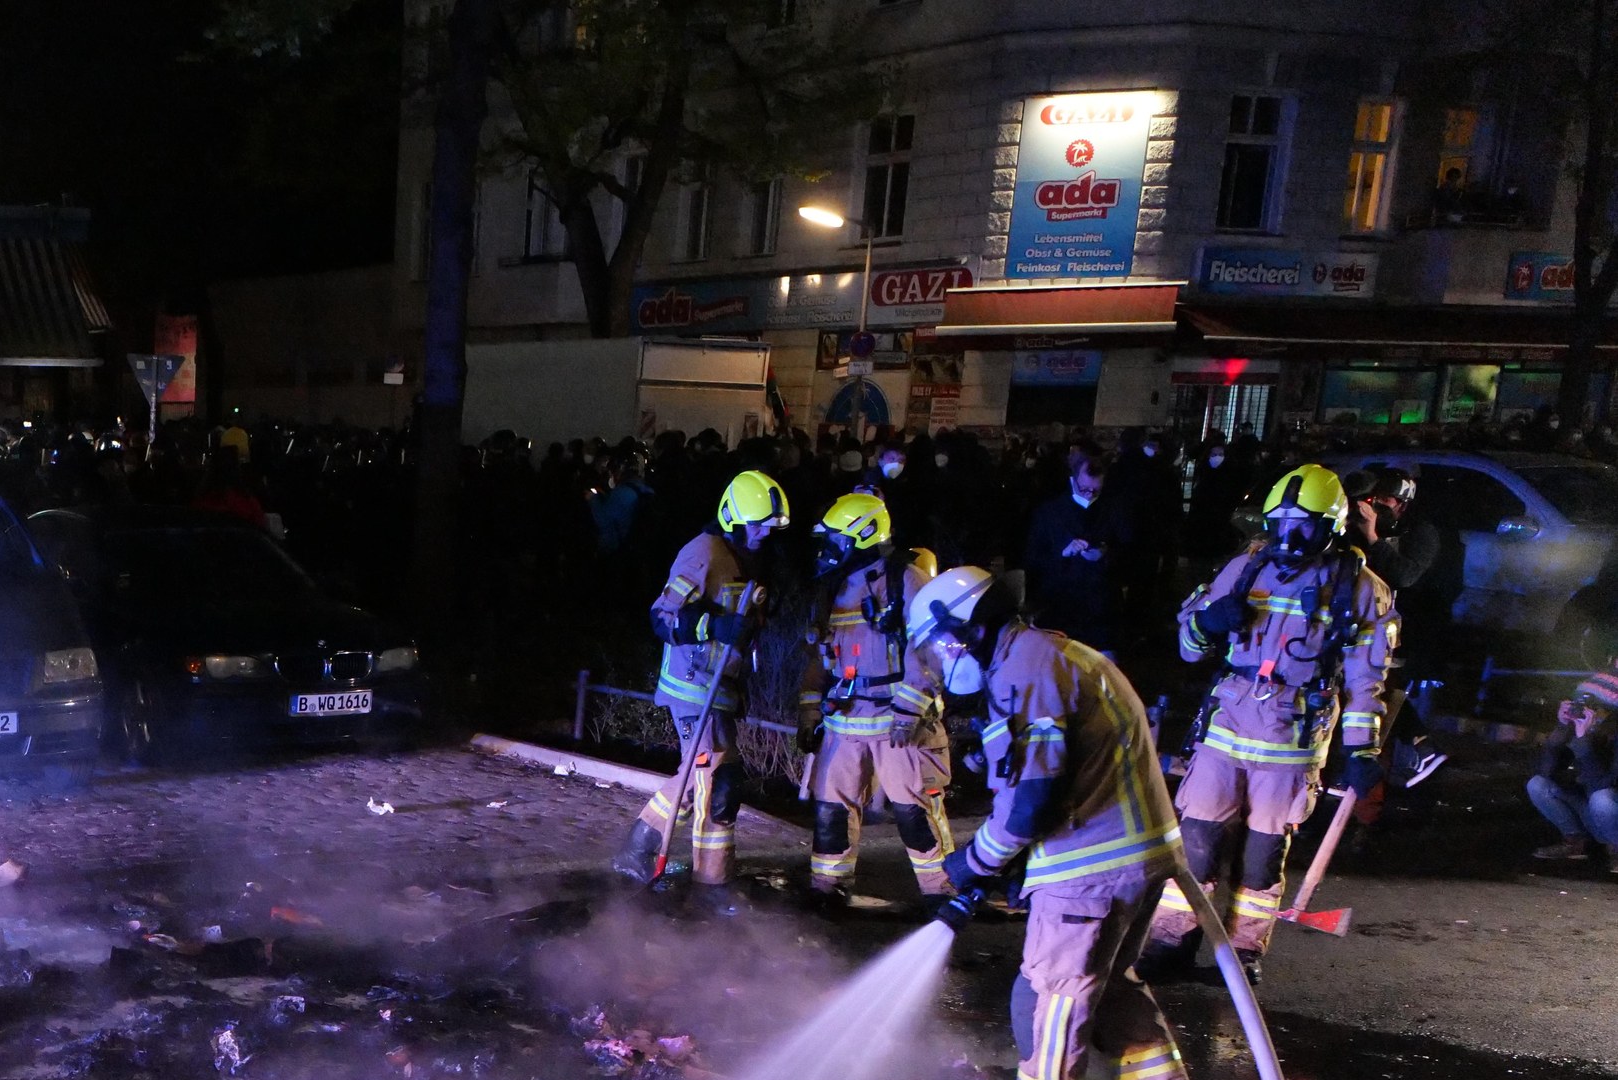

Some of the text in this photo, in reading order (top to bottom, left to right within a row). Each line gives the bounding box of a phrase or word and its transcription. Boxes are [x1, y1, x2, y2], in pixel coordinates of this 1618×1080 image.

[1037, 173, 1118, 207] ada
[1050, 208, 1103, 221] Supermarkt
[1034, 232, 1103, 244] Lebensmittel
[1025, 247, 1112, 259] Obst & Gemüse
[1016, 260, 1125, 273] Feinkost Fleischerei
[1209, 260, 1301, 284] Fleischerei
[1541, 261, 1575, 288] ad
[299, 697, 308, 711] B
[318, 696, 335, 710] WQ
[338, 694, 369, 709] 1616
